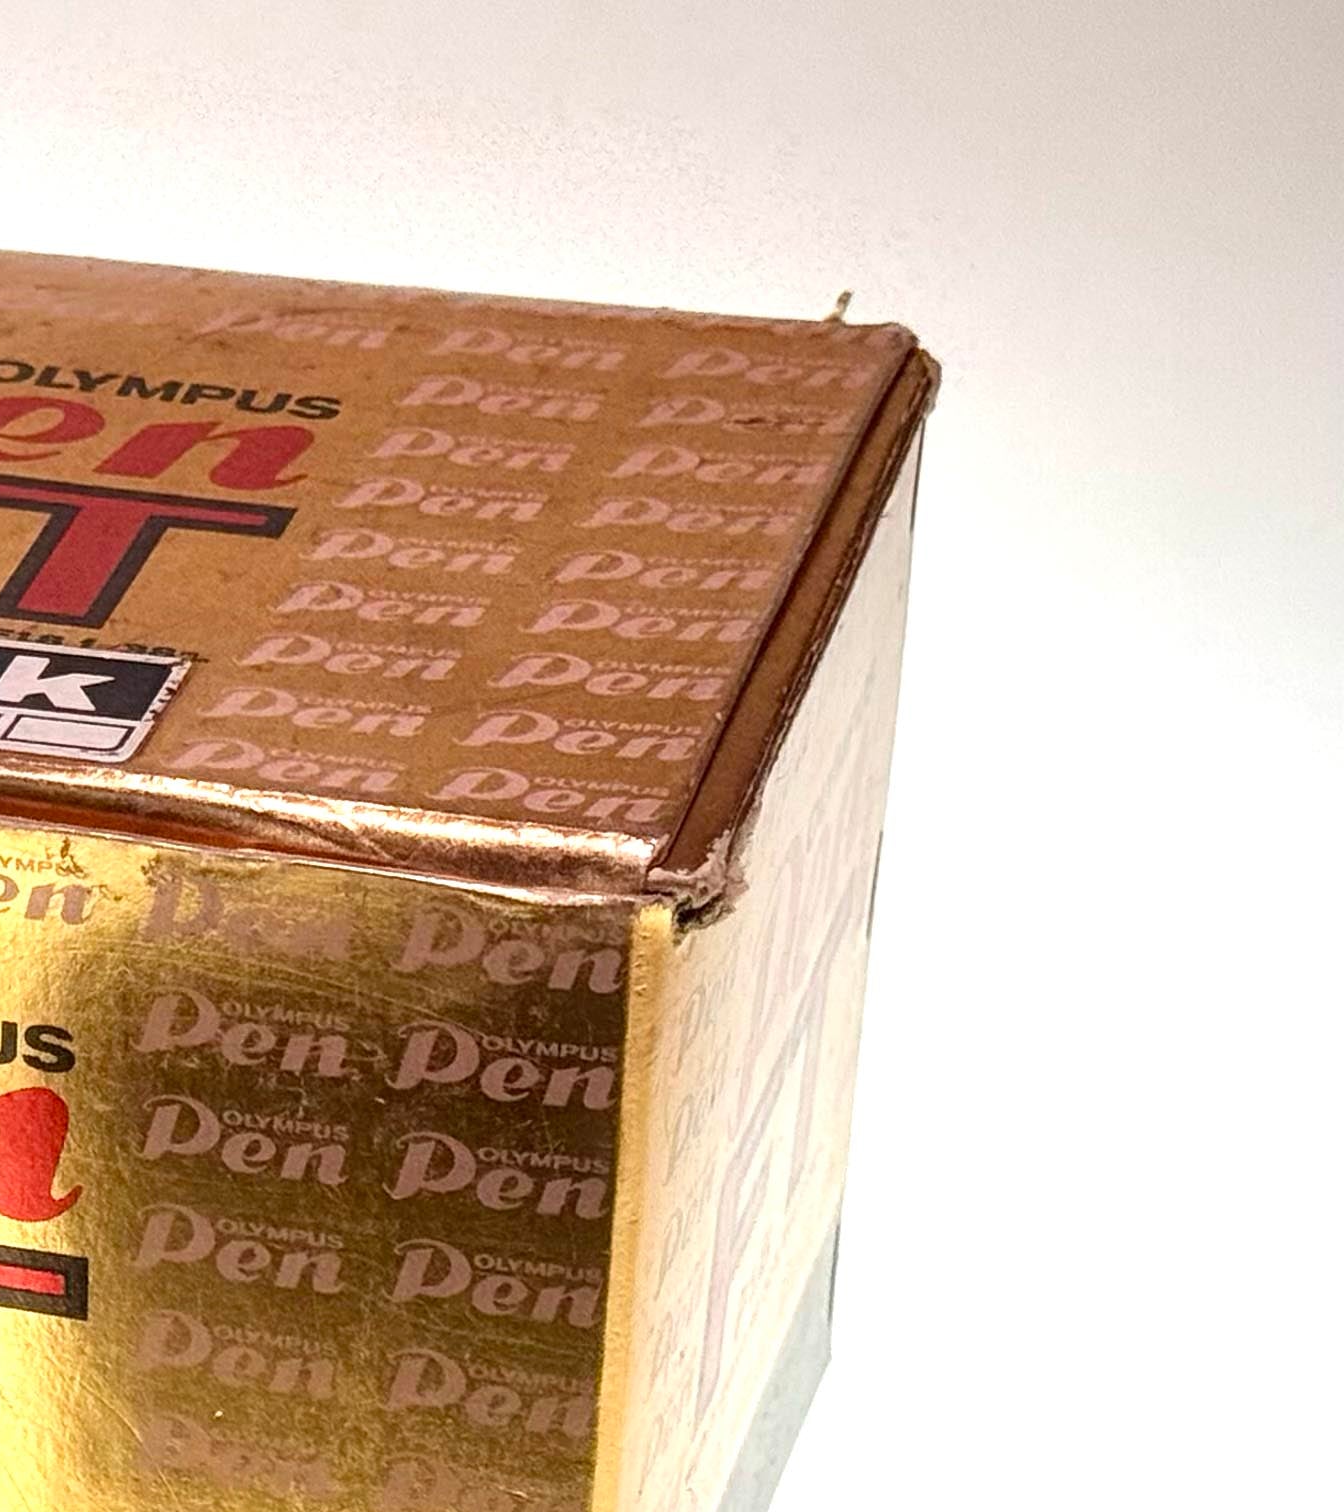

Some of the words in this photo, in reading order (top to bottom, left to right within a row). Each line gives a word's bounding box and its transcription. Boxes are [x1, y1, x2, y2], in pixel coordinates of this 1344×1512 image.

[367, 426, 572, 471] Pen
[331, 479, 544, 521] Pen
[299, 529, 514, 574] Pen
[551, 550, 772, 589] Pen
[269, 580, 487, 627] Pen
[518, 600, 761, 642] Pen
[232, 632, 456, 680] Pen
[487, 652, 725, 700] Pen
[197, 685, 426, 736] Pen
[454, 709, 696, 760] Pen
[164, 738, 401, 793] Pen
[425, 767, 669, 823] Pen
[390, 906, 624, 994] Pen
[132, 985, 350, 1079] Pen
[482, 1036, 618, 1063] OLYMPUS
[386, 1020, 616, 1111] Pen
[136, 1094, 349, 1185] Pen
[223, 1110, 350, 1142] OLYMPUS
[382, 1131, 609, 1219] Pen
[476, 1146, 612, 1175] OLYMPUS
[132, 1204, 349, 1295] Pen
[218, 1219, 344, 1250] OLYMPUS
[387, 1238, 603, 1329] Pen
[474, 1252, 603, 1281] OLYMPUS
[382, 1349, 596, 1439] Pen
